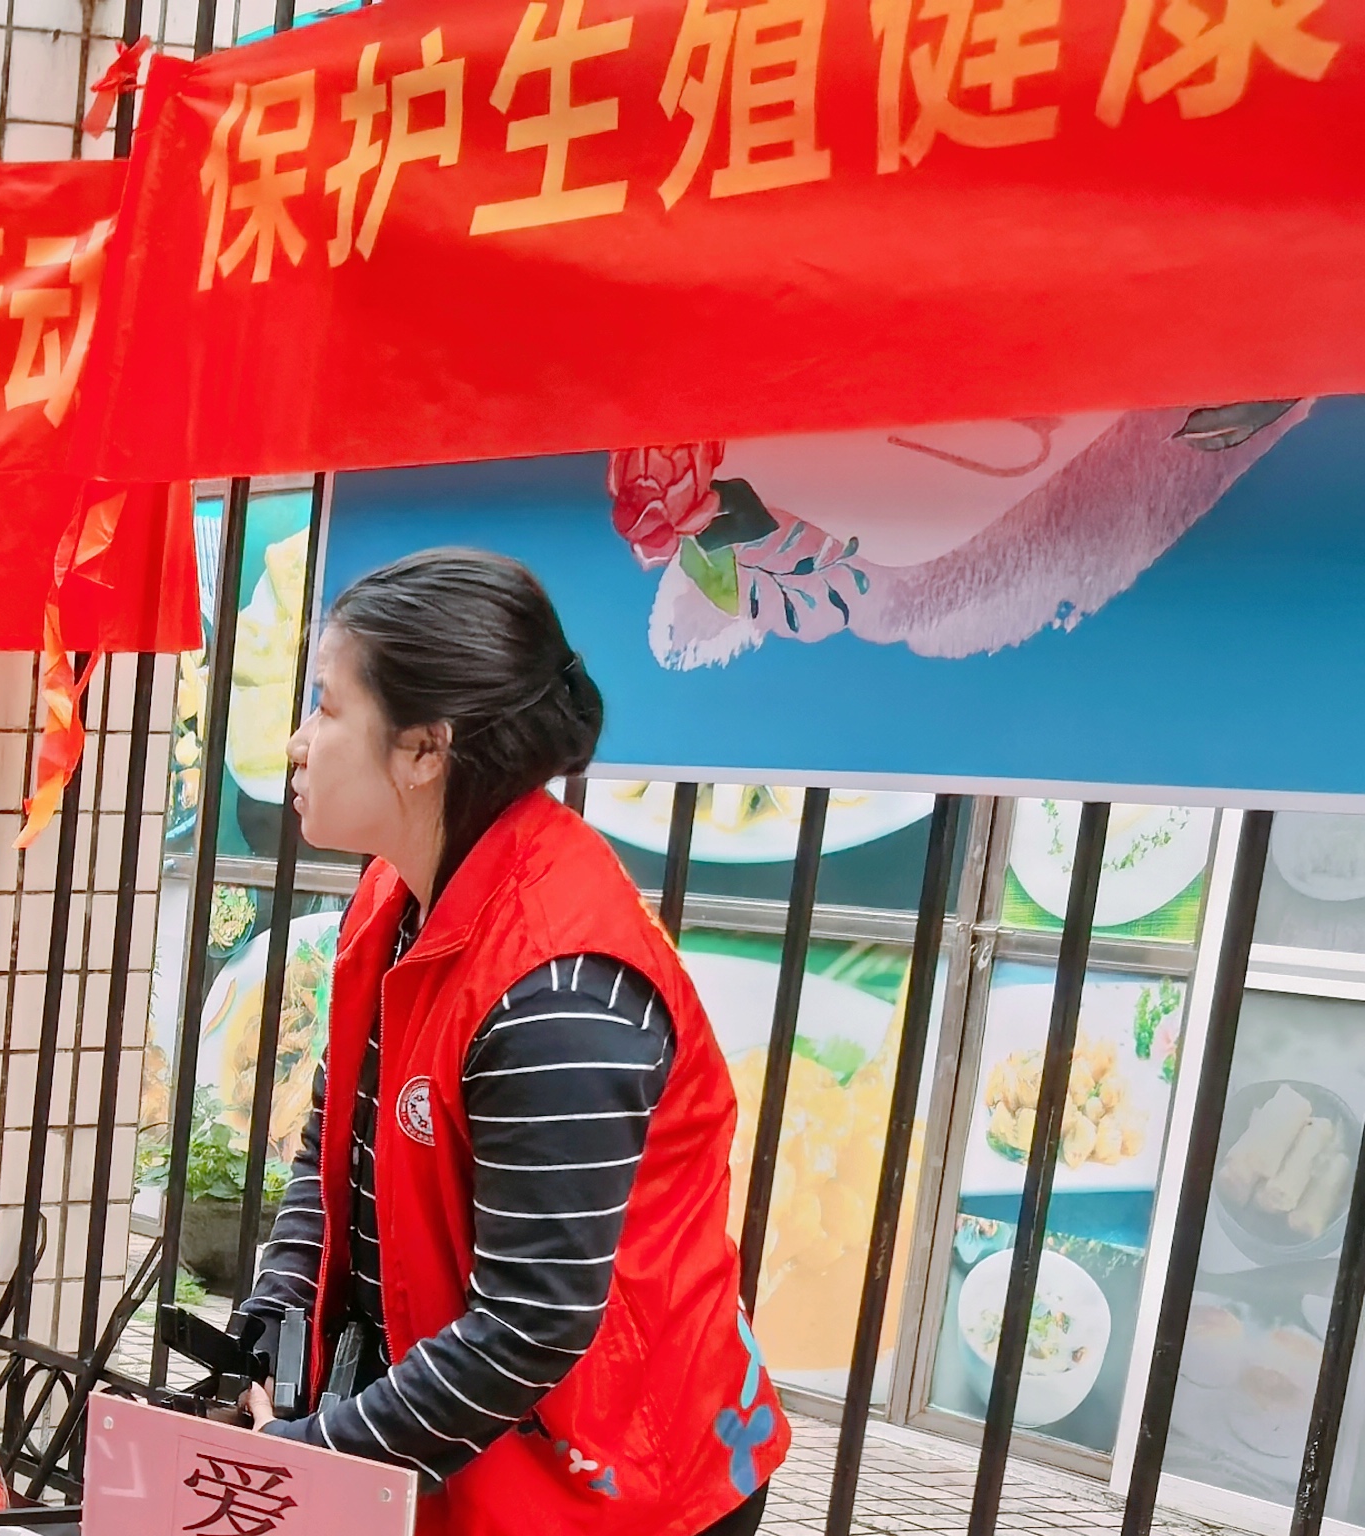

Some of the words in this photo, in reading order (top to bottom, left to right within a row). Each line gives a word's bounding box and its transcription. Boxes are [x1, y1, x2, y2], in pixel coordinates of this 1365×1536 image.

[197, 0, 1341, 292] 保护生殖健康
